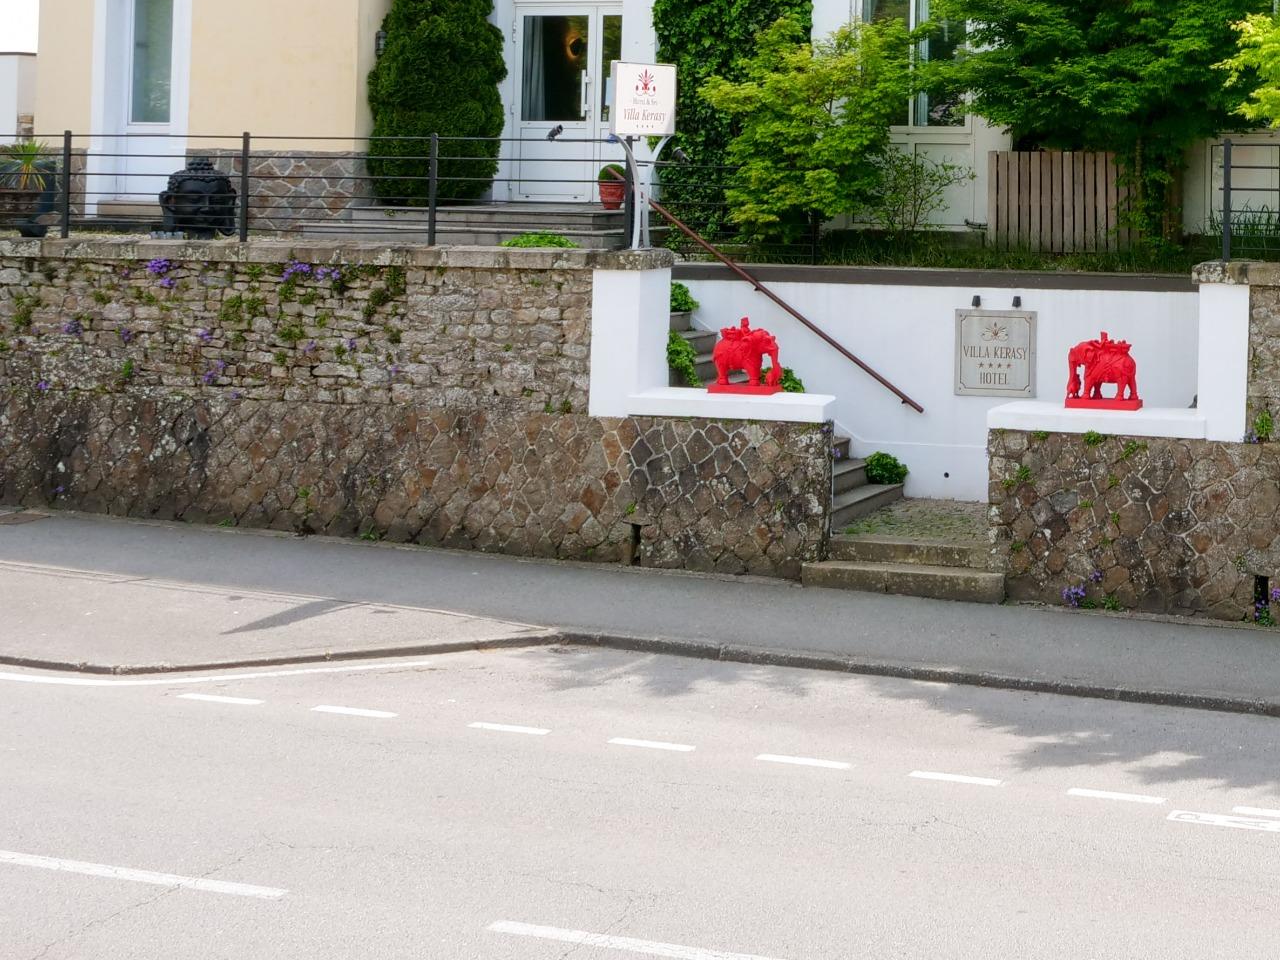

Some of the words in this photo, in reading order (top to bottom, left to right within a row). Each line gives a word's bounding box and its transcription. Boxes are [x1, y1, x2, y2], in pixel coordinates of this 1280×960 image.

[623, 107, 640, 121] Villa
[641, 109, 666, 124] Kerasy
[963, 345, 990, 359] VILLA
[993, 346, 1028, 360] KERASY
[979, 372, 1008, 385] HOTEL
